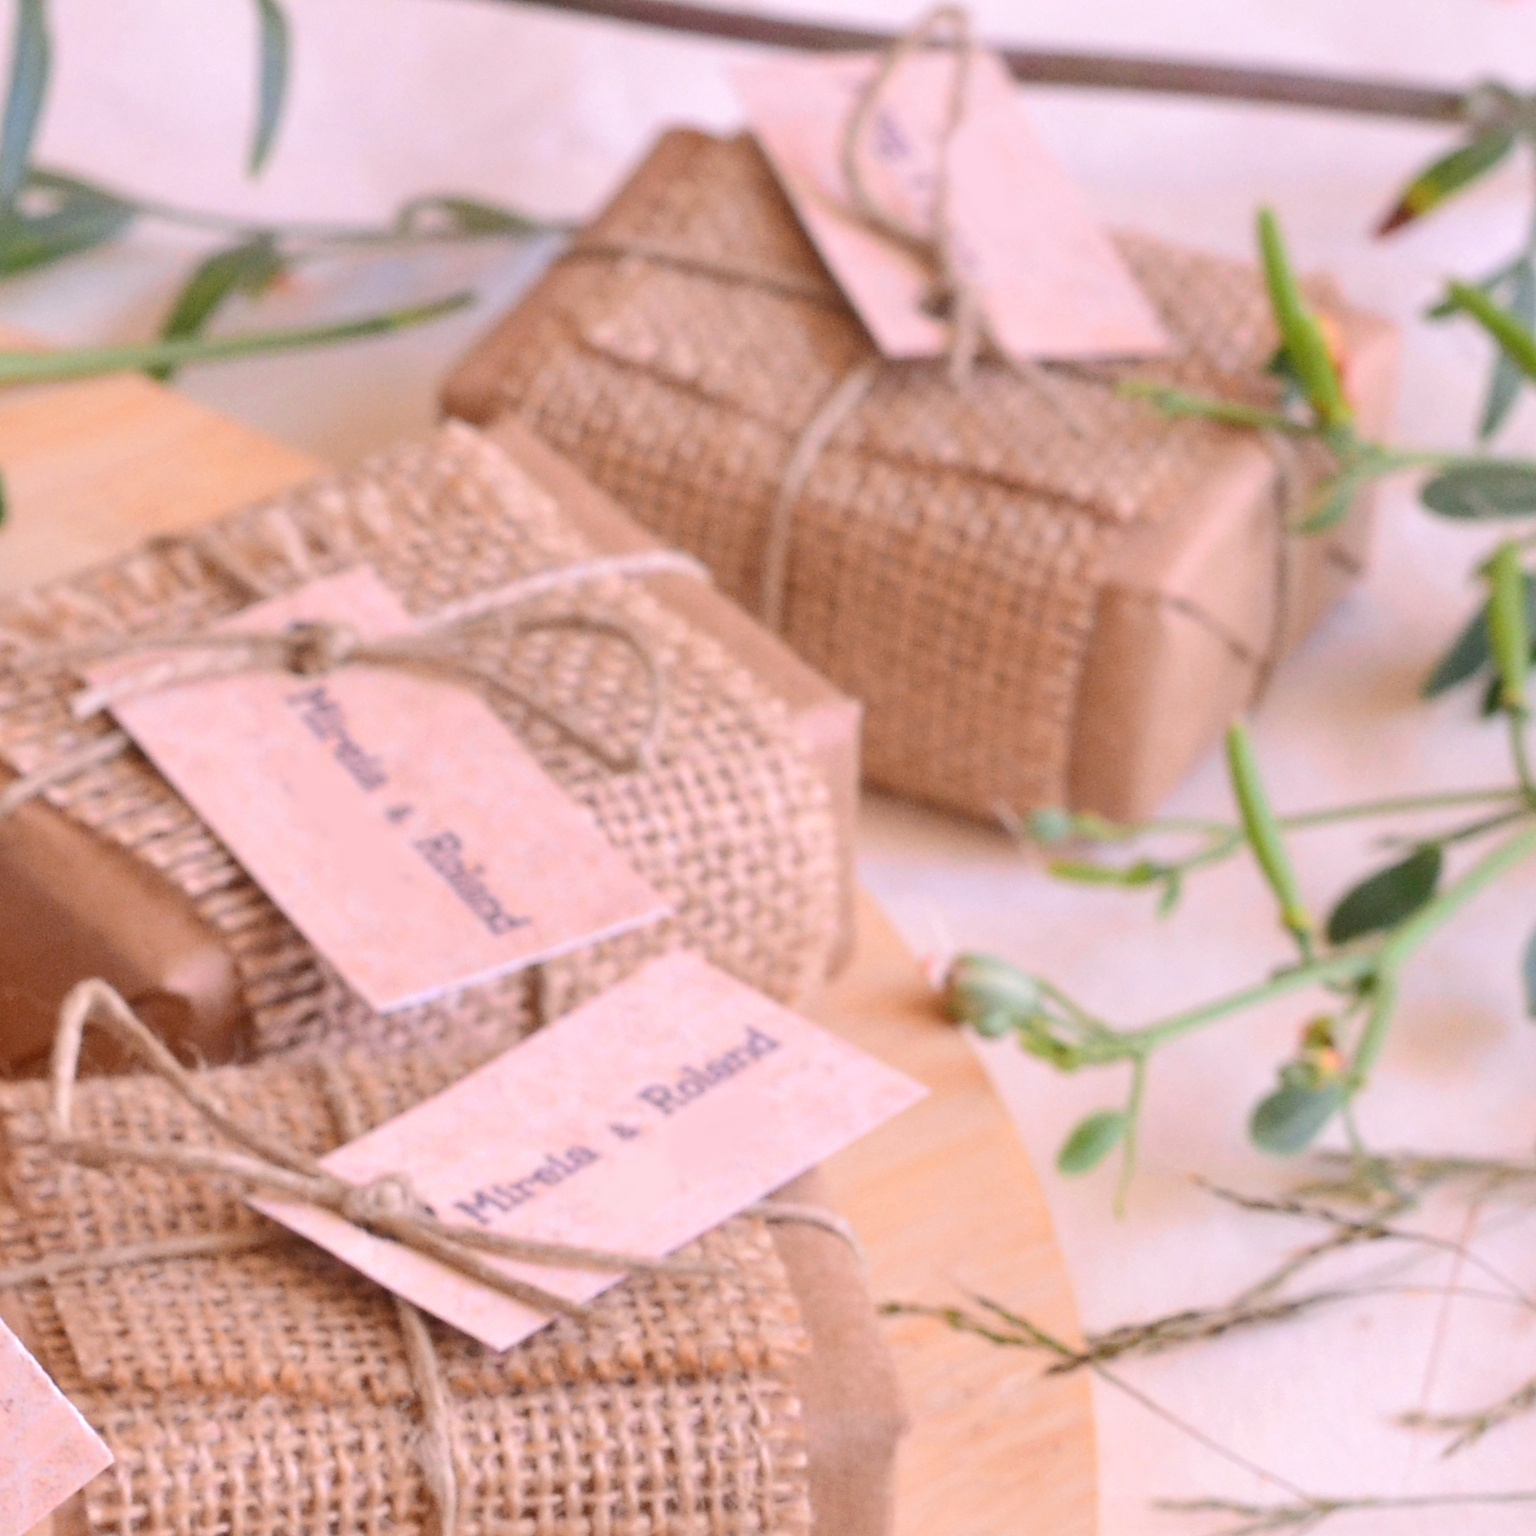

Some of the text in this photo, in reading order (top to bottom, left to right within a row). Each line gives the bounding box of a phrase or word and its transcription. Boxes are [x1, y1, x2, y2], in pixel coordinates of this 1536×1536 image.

[454, 1027, 780, 1225] Mireia & Roland
